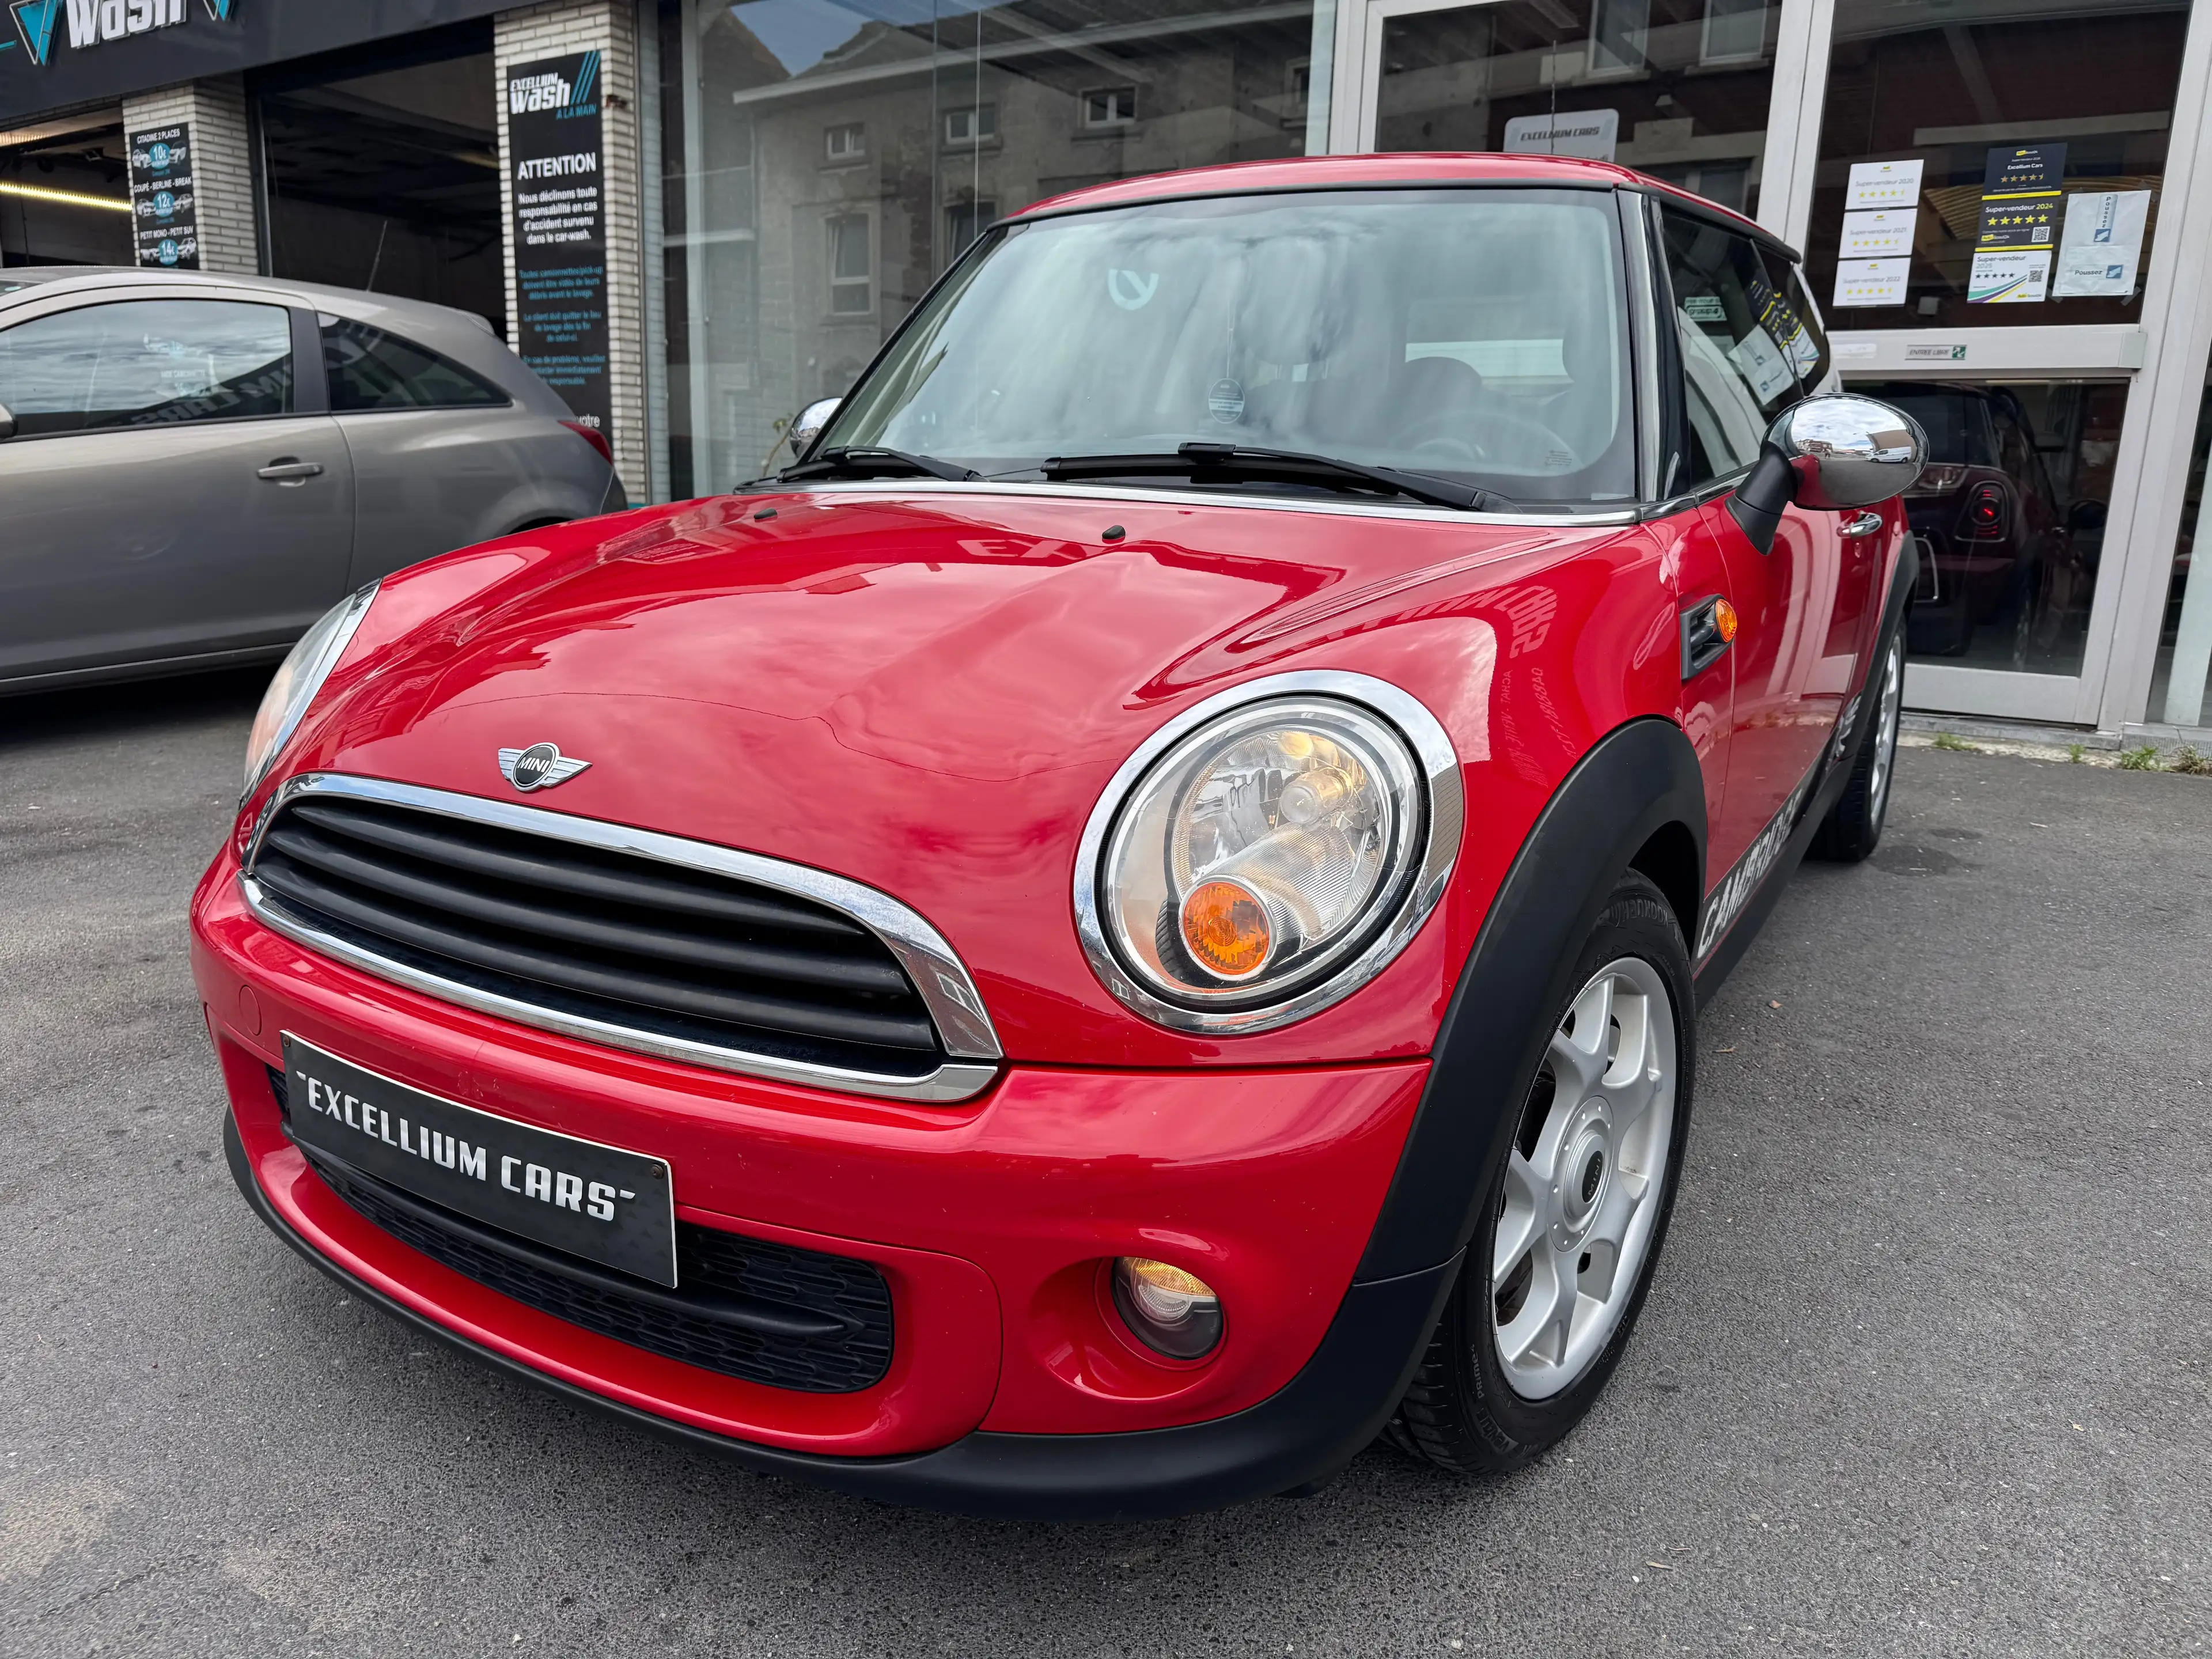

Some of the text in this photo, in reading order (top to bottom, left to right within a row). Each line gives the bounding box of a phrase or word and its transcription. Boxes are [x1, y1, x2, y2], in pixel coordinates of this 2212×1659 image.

[510, 72, 558, 92] EXCELLIUM
[577, 104, 597, 118] MAIN
[162, 128, 180, 139] PLACES
[1573, 126, 1600, 137] CARS
[517, 152, 596, 180] ATTENTION
[134, 181, 149, 193] COUPÉ
[152, 179, 172, 191] BERLINE
[175, 176, 192, 187] BREAK
[518, 186, 597, 204] Nous déclinons toute
[519, 202, 597, 219] responsabilité en cas
[1985, 204, 2035, 213] Super-vendeur
[523, 216, 594, 232] d'accident survenu
[140, 230, 152, 240] PETIT
[153, 229, 167, 238] MONO
[170, 226, 183, 236] PETIT
[183, 225, 194, 234] SUV
[527, 233, 546, 245] dans
[547, 232, 554, 243] le
[517, 757, 550, 772] MINI
[308, 1076, 616, 1221] EXCELLIUM CARS
[1588, 1158, 1601, 1195] MINI
